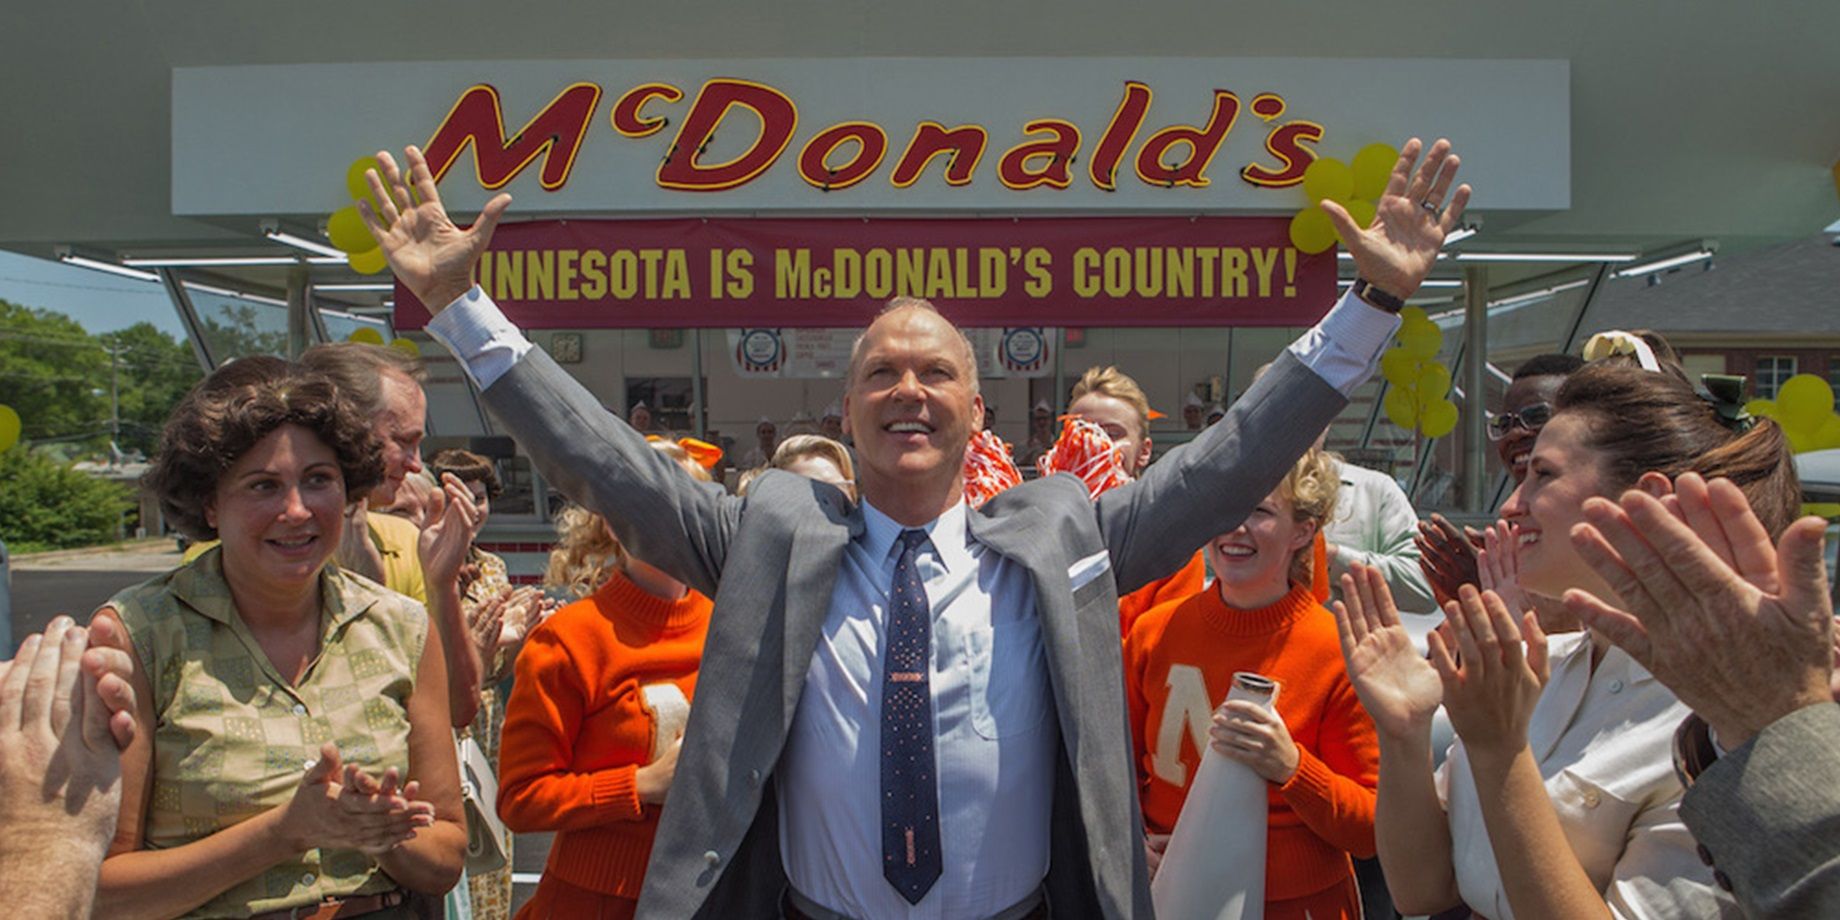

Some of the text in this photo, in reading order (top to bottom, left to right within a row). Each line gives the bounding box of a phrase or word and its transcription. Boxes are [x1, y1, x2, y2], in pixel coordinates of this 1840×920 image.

[405, 78, 1325, 192] McDonald's
[470, 246, 1298, 300] INNESOTA IS McDONALD'S COUNTRY!
